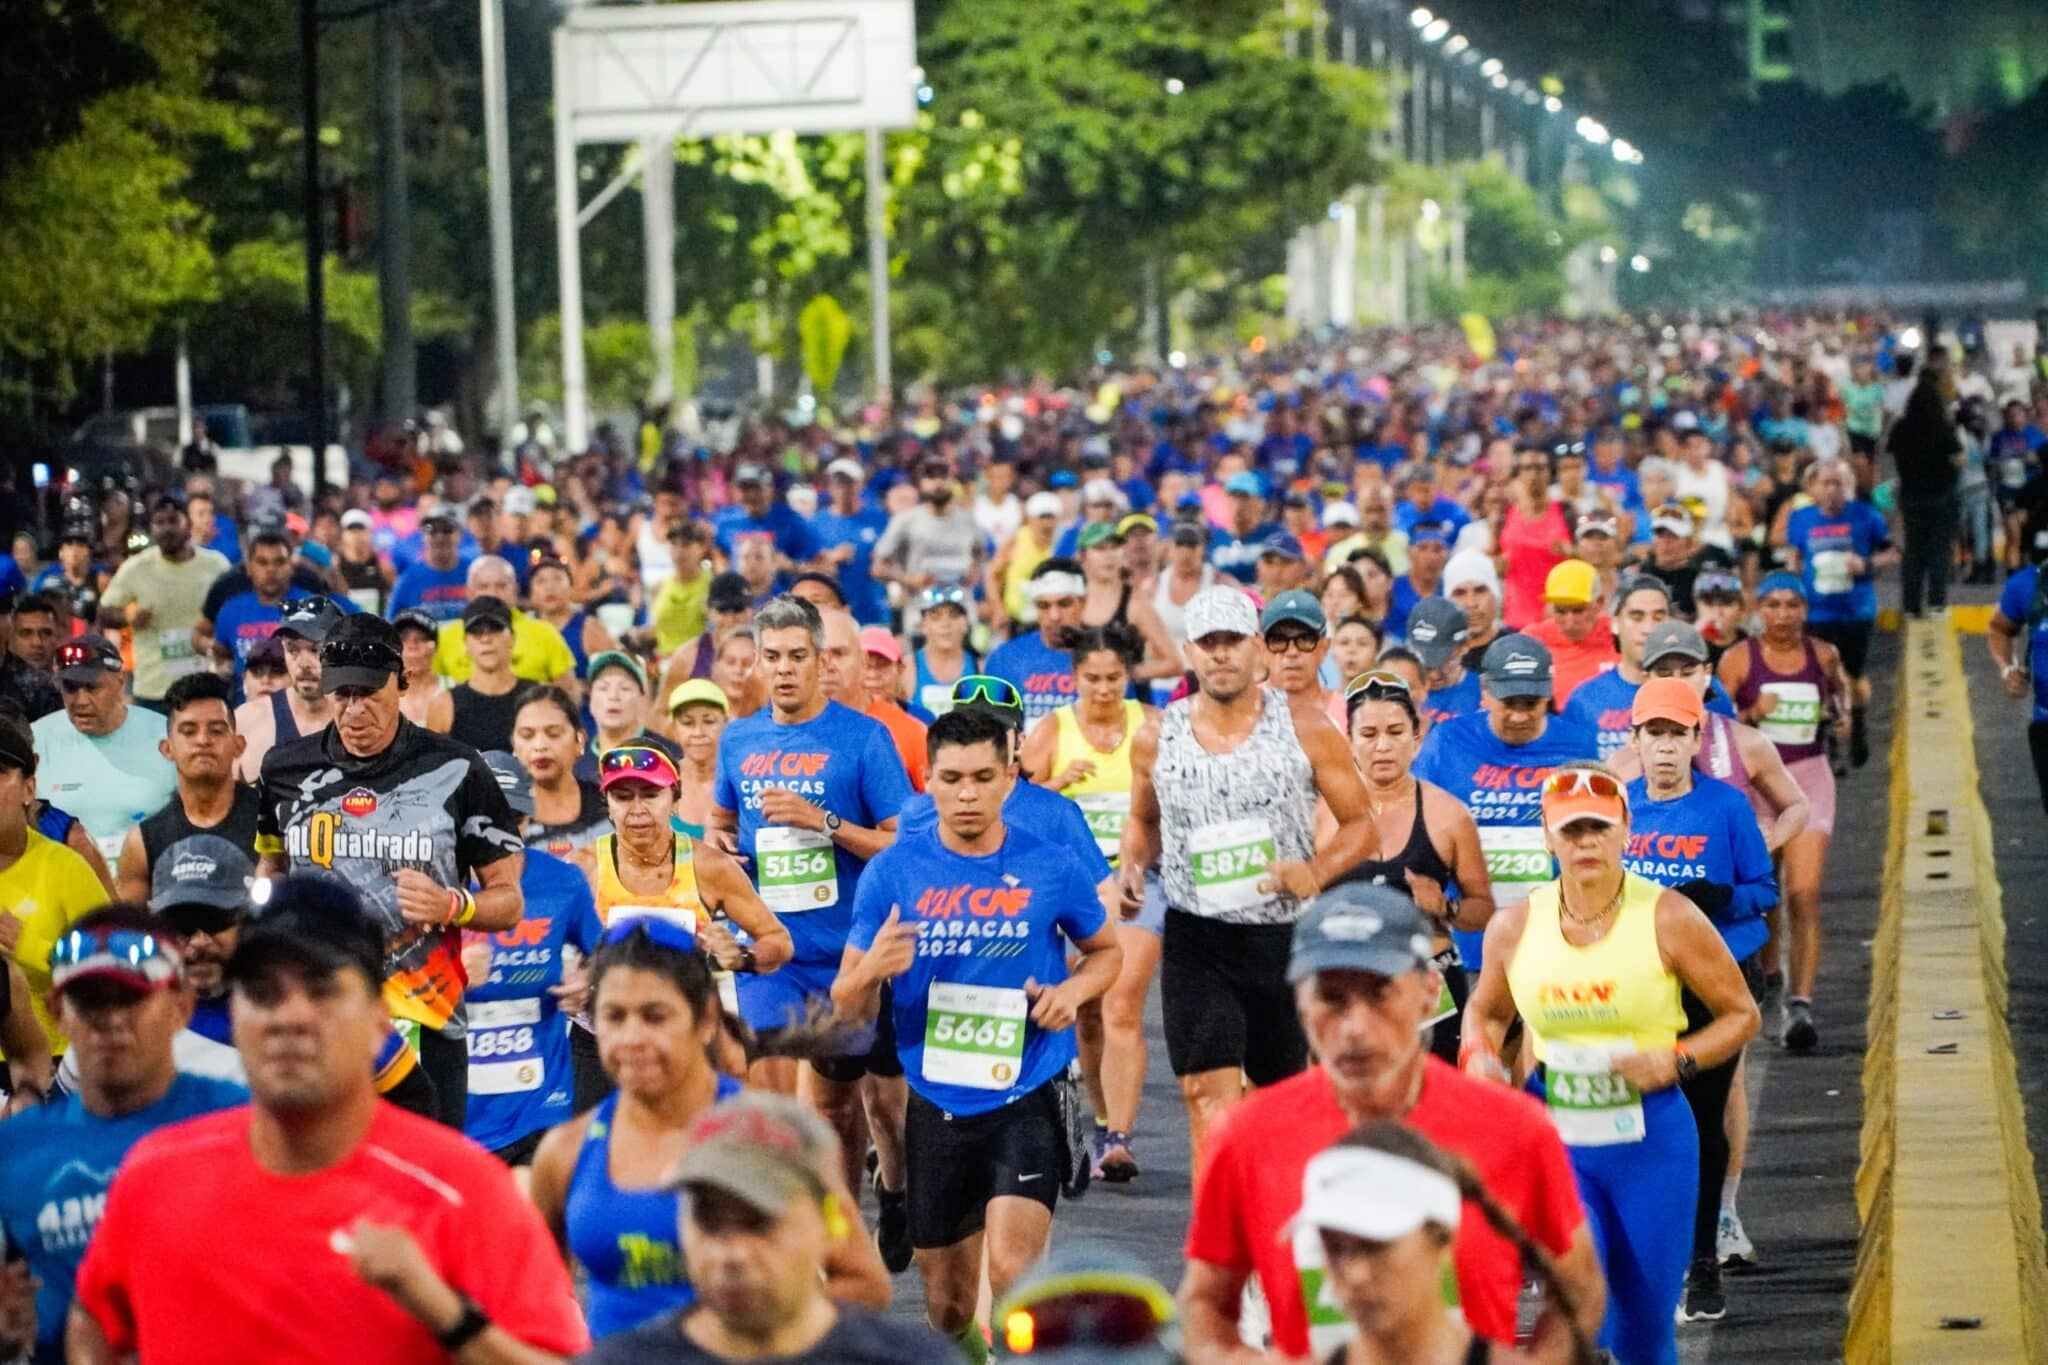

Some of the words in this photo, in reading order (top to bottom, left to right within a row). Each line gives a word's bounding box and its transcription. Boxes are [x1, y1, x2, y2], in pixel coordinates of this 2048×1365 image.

[741, 750, 783, 777] 42K
[1470, 790, 1540, 805] CARAC
[1656, 835, 1708, 859] CAF
[765, 851, 828, 877] 5156
[1200, 846, 1268, 878] 5874
[1621, 860, 1706, 878] CARACAS
[915, 884, 972, 919] 42K
[969, 888, 1032, 916] CAF
[916, 920, 1030, 938] CARACAS
[493, 949, 551, 967] ACAS
[918, 939, 972, 957] 2024
[934, 1015, 1018, 1049] 5665
